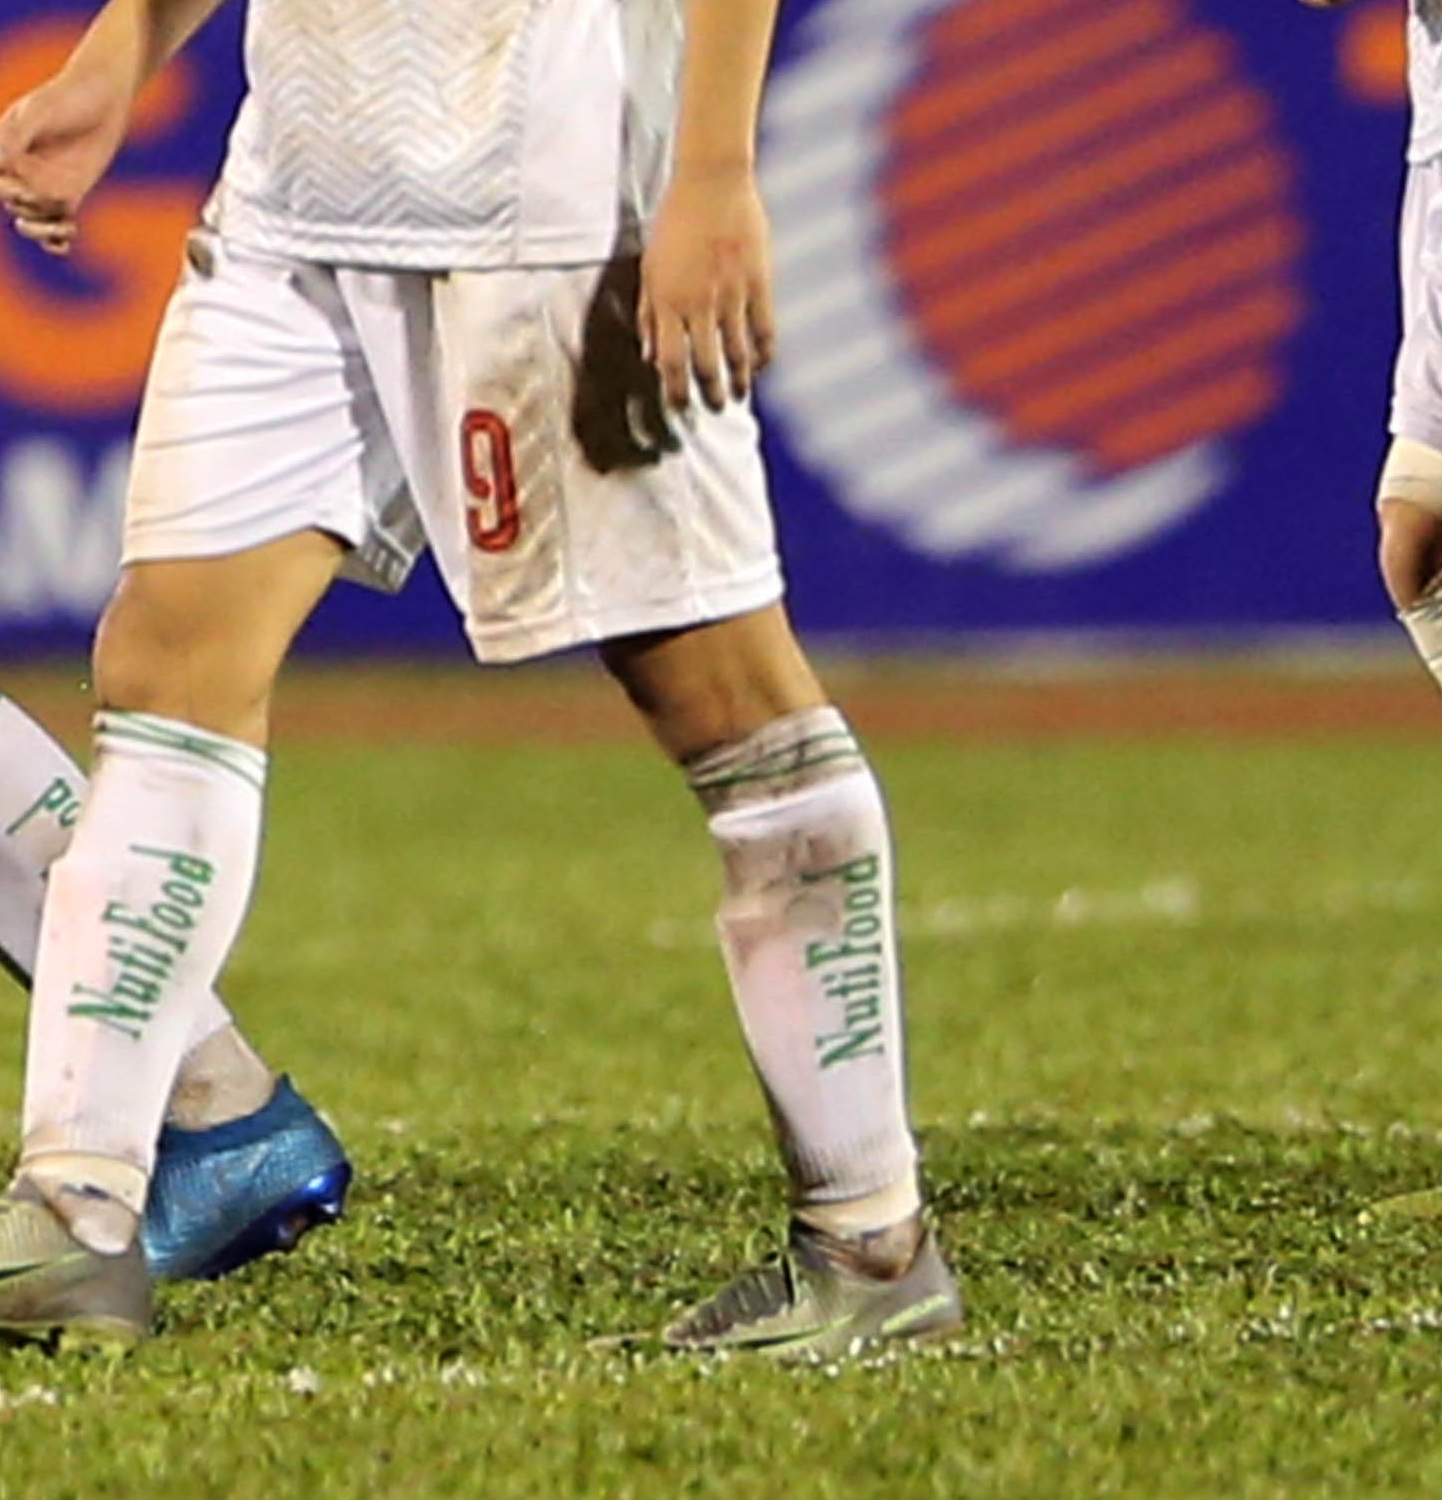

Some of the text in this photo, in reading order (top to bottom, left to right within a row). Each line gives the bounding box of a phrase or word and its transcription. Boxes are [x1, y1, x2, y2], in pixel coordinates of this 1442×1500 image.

[460, 409, 519, 553] 9
[67, 843, 214, 1040] NutiFood
[801, 854, 884, 1070] NutiFood
